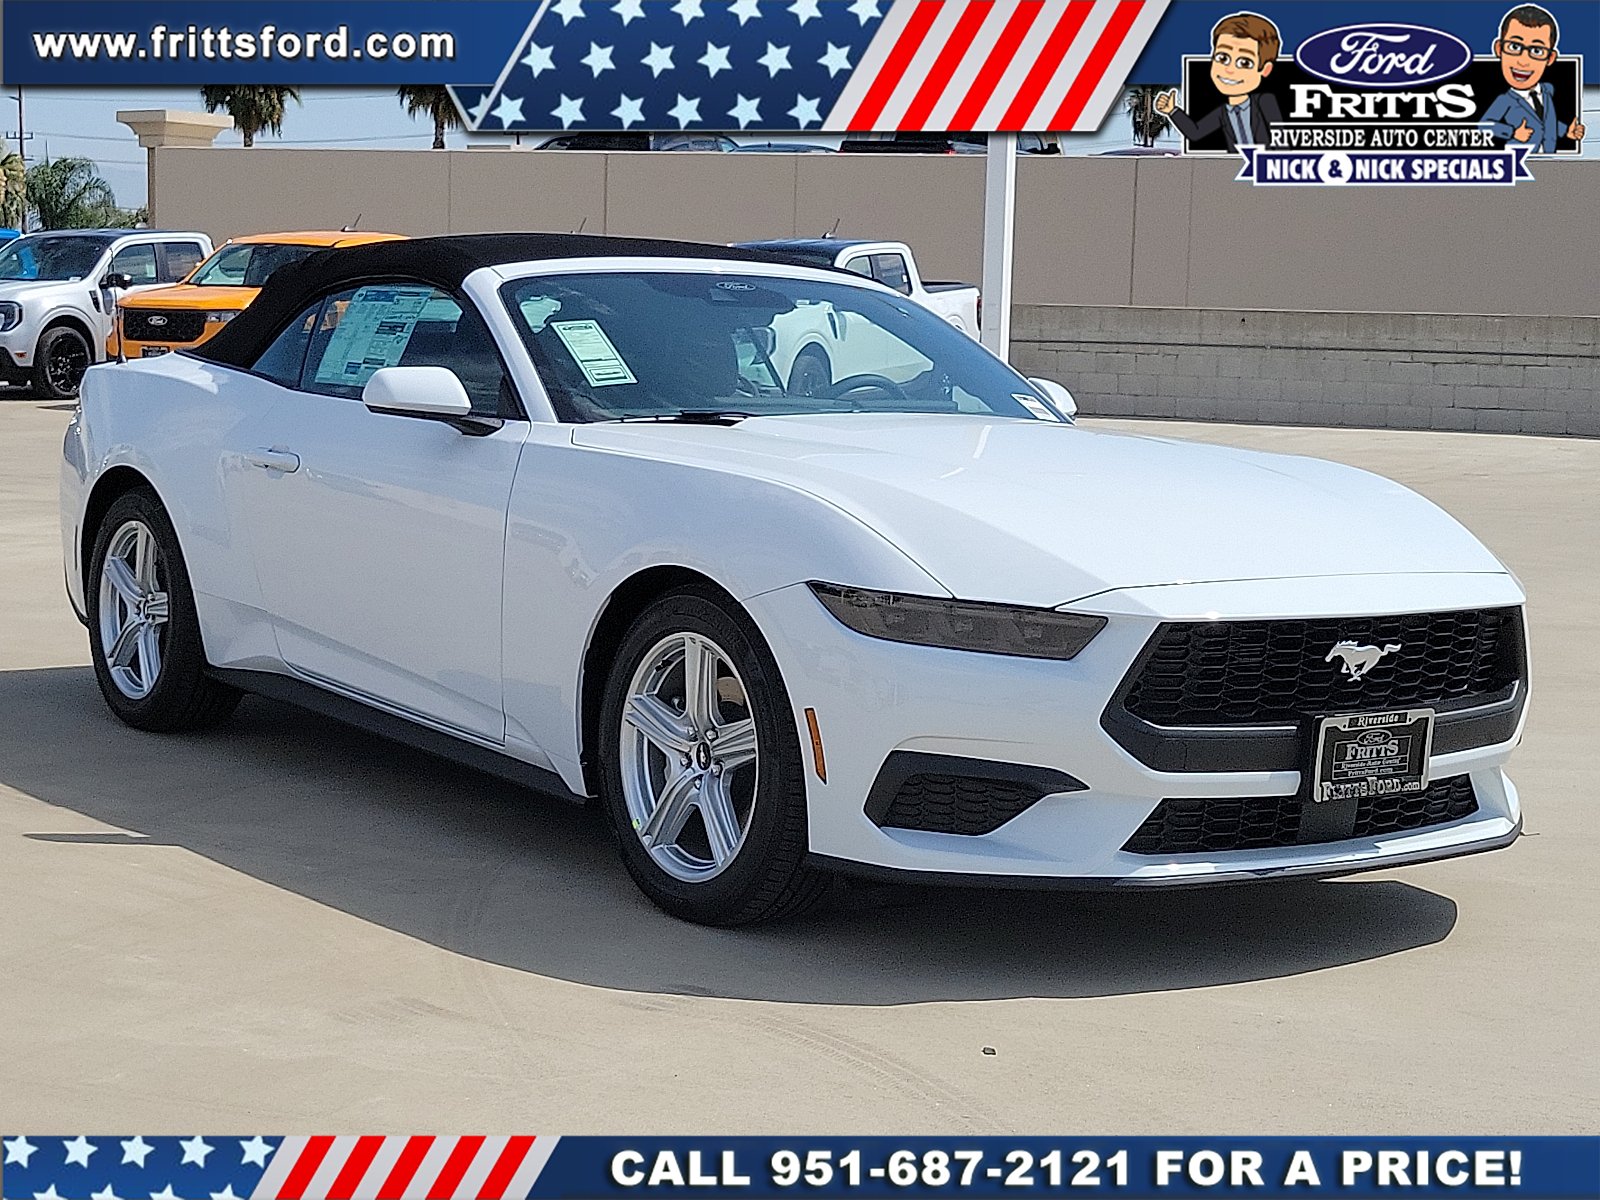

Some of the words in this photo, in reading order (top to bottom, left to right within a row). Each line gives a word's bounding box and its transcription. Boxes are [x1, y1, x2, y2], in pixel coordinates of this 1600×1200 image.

[1356, 714, 1399, 727] Riverside
[1363, 732, 1385, 744] Ford
[1345, 740, 1399, 760] FRITTS
